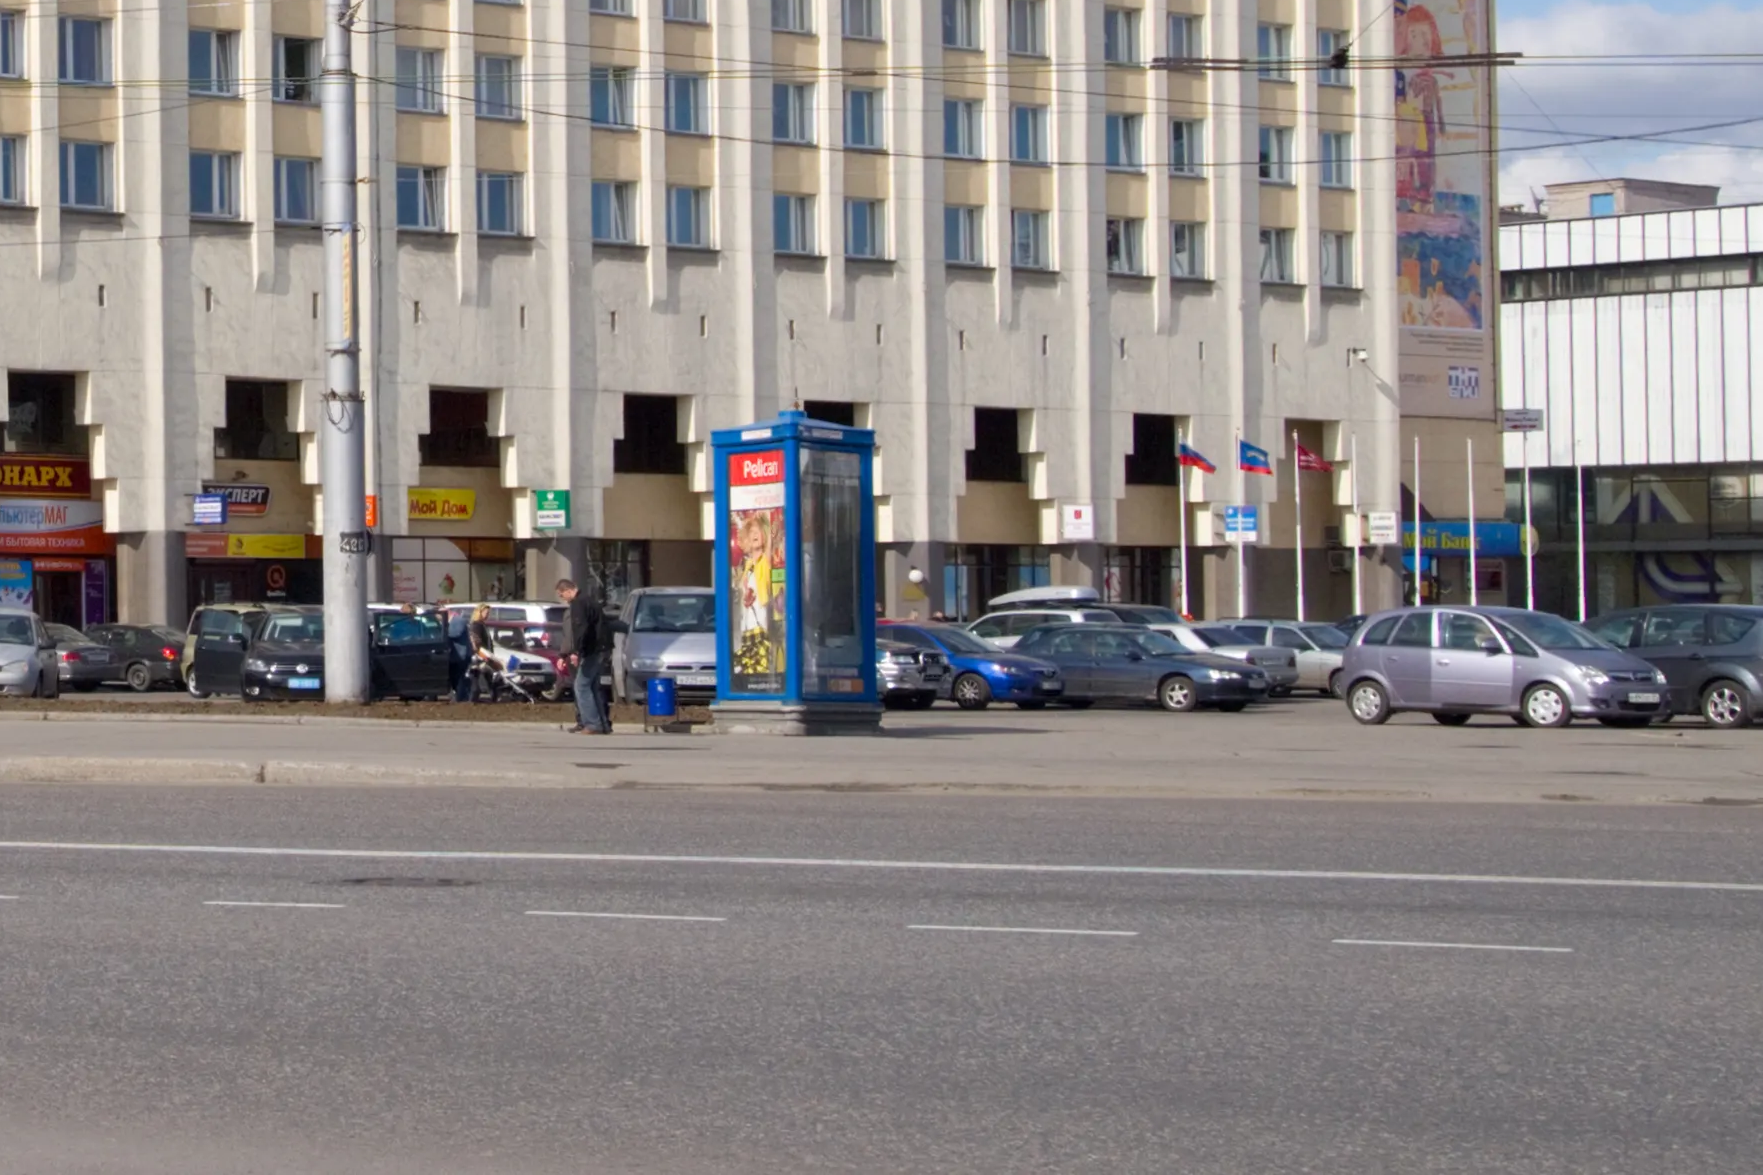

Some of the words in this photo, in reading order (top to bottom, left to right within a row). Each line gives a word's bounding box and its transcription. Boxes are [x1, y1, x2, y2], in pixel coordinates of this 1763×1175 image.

[743, 458, 779, 479] Pelican
[409, 499, 437, 516] Мой
[440, 499, 469, 517] Дом
[6, 537, 46, 548] БЫТОВАЯ
[47, 537, 86, 549] ТЕХНИКА
